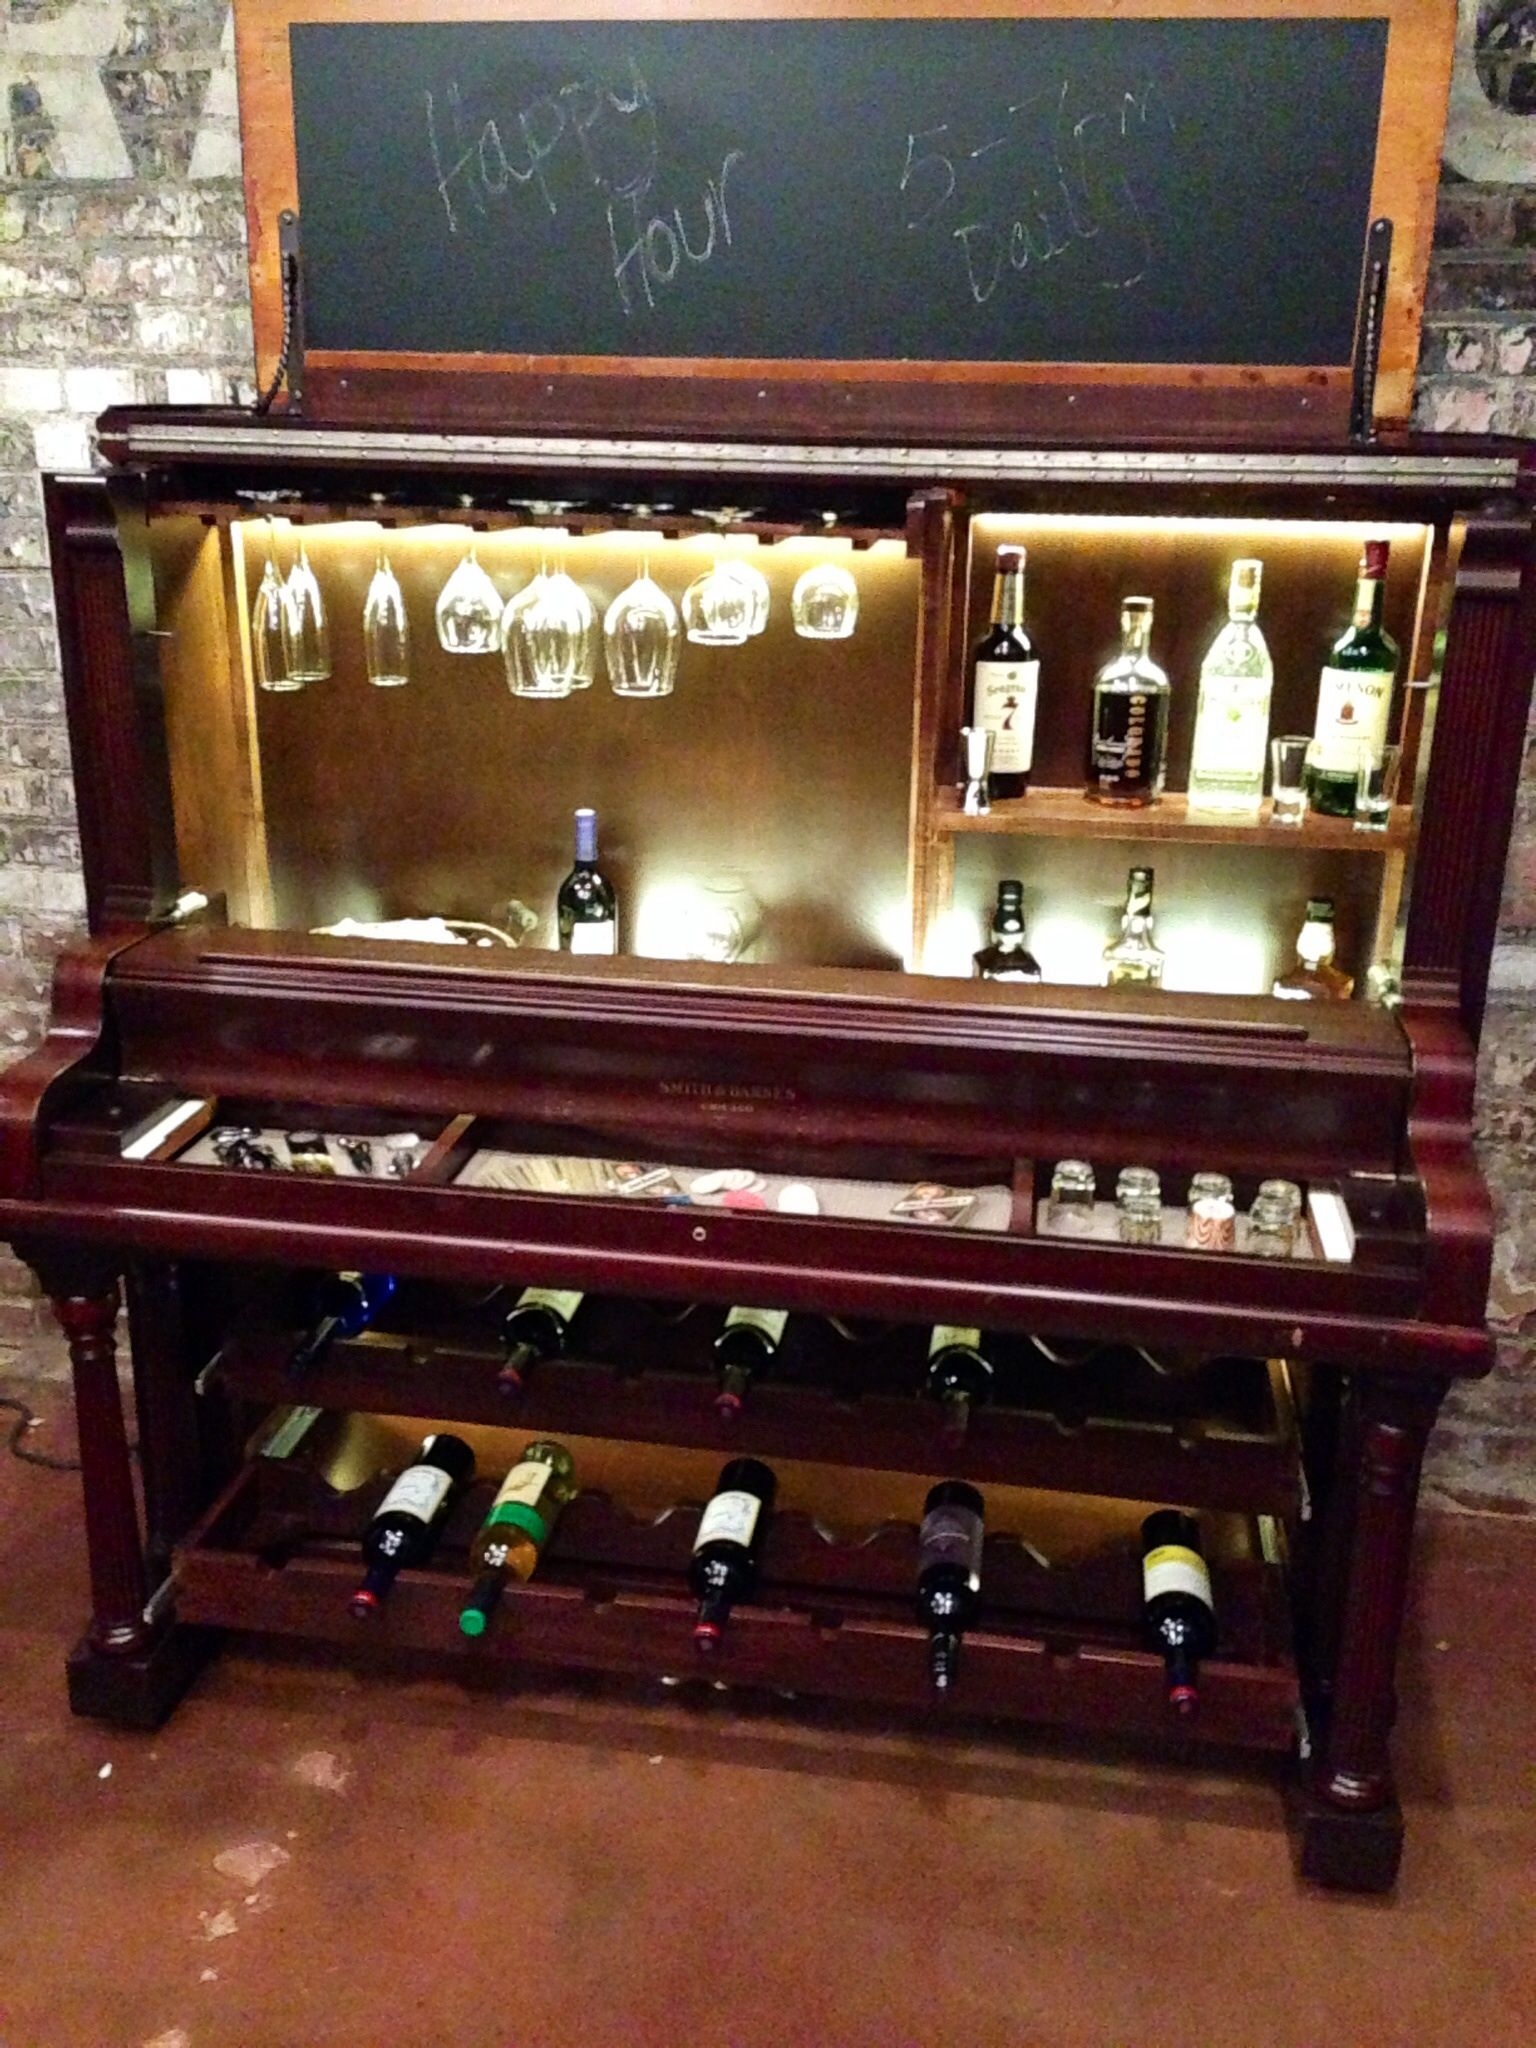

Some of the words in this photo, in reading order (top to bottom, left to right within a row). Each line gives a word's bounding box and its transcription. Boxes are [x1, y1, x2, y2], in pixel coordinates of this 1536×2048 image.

[425, 57, 658, 233] Happy
[606, 148, 745, 315] Hour
[1001, 702, 1019, 731] 7
